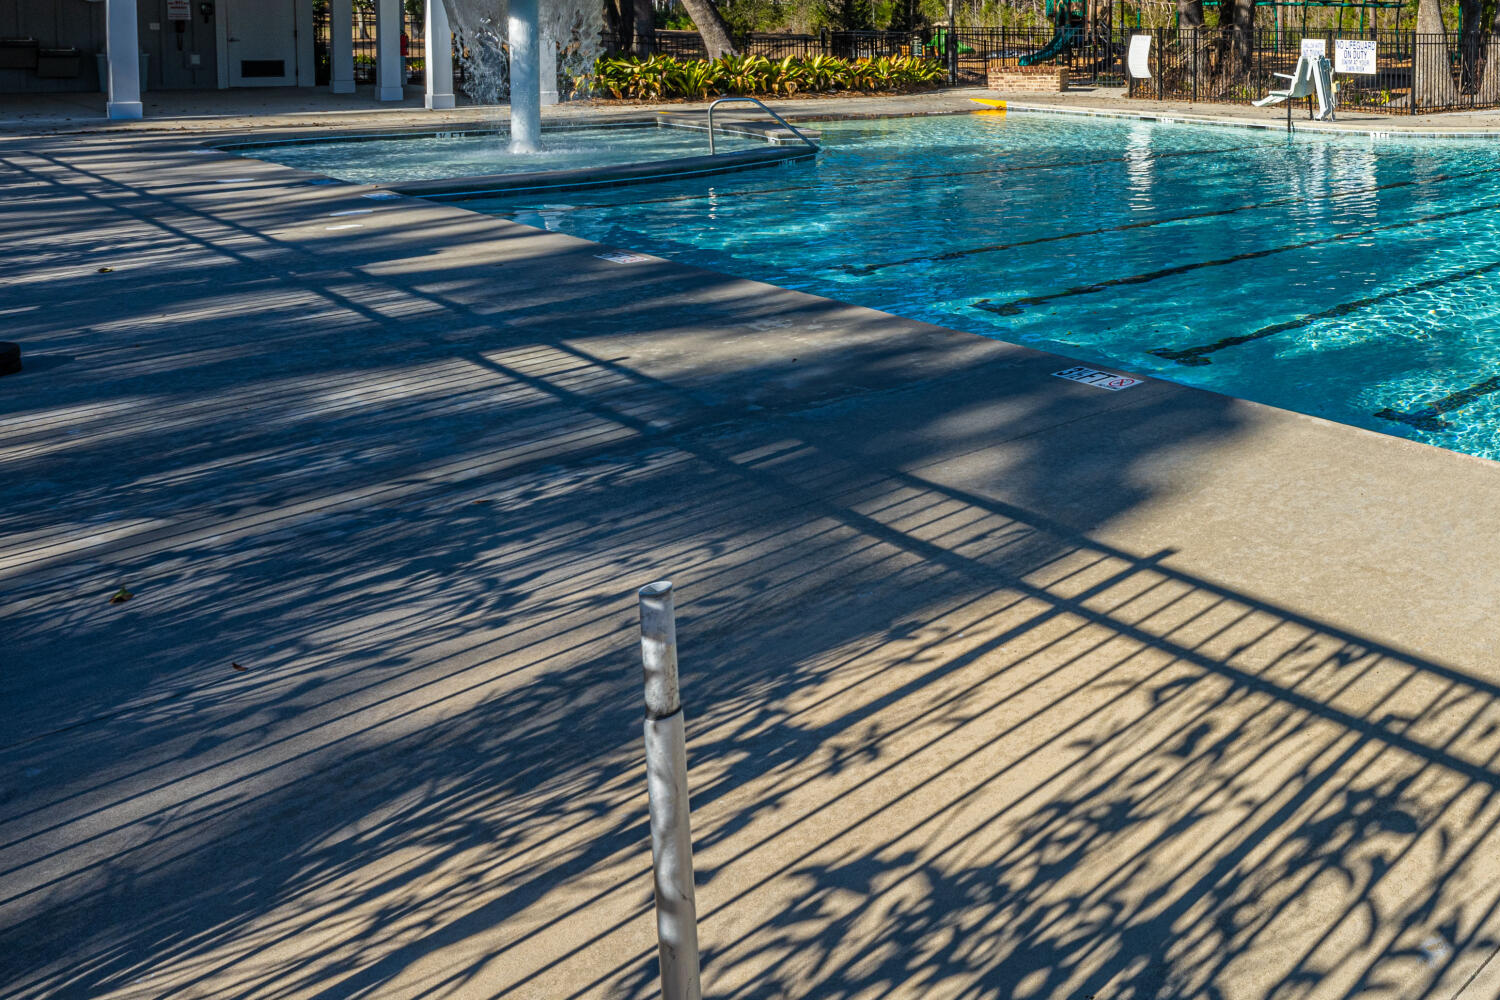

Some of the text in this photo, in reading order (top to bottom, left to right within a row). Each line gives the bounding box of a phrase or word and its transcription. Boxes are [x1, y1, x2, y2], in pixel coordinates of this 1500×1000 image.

[1345, 40, 1376, 51] LIFEGUARD
[1343, 50, 1368, 60] ON DUTY
